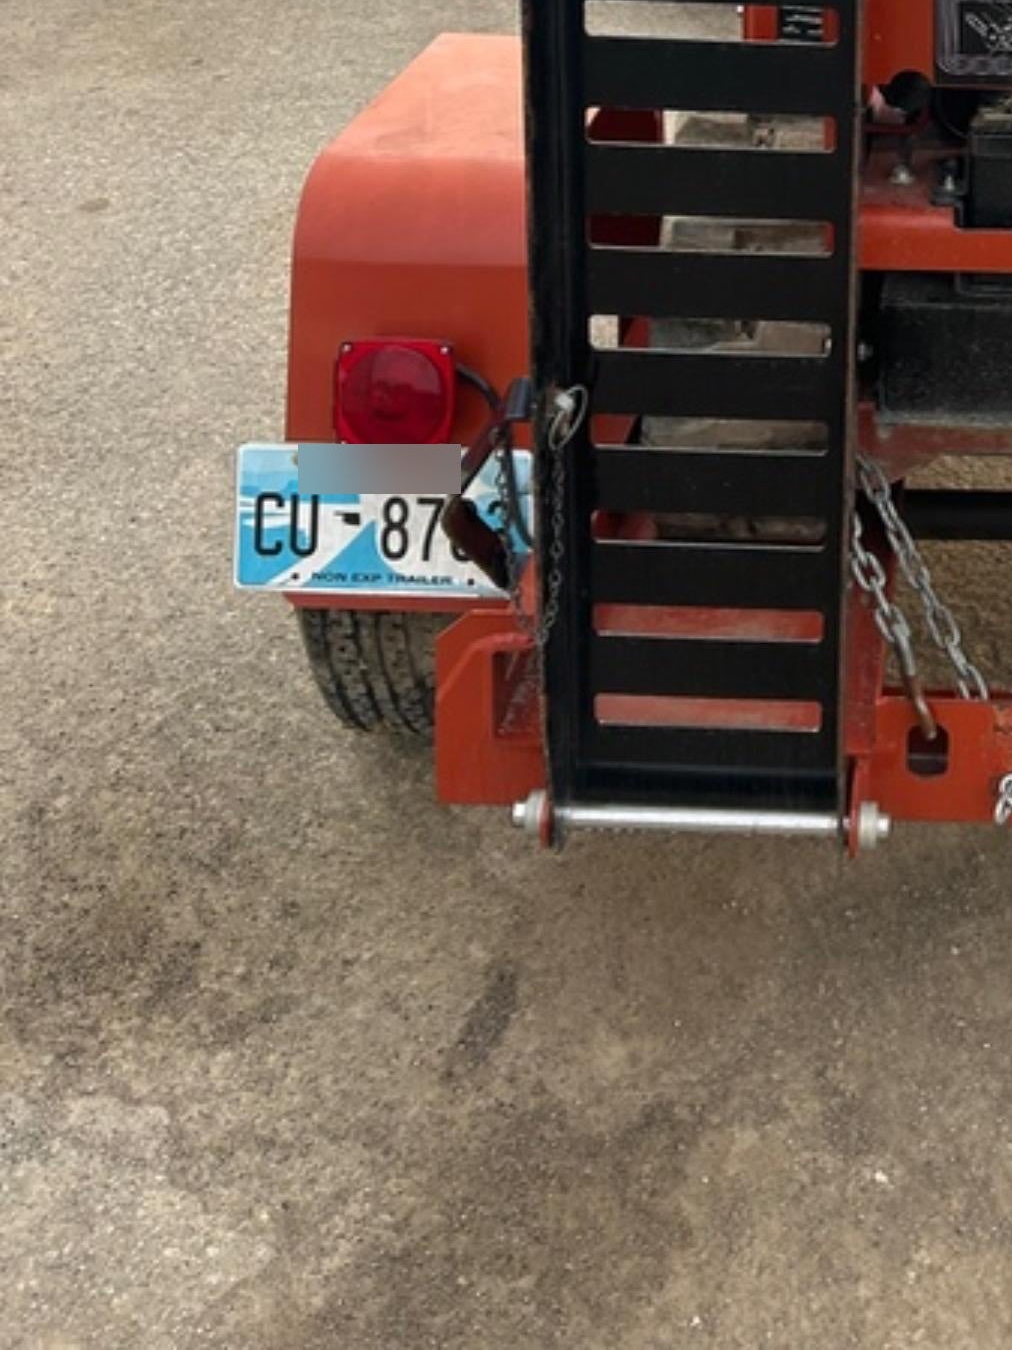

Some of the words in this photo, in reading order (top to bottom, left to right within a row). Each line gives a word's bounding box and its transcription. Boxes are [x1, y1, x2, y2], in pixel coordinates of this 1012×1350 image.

[311, 571, 347, 583] NON
[351, 572, 382, 584] EXP
[387, 572, 454, 586] TRAILER
